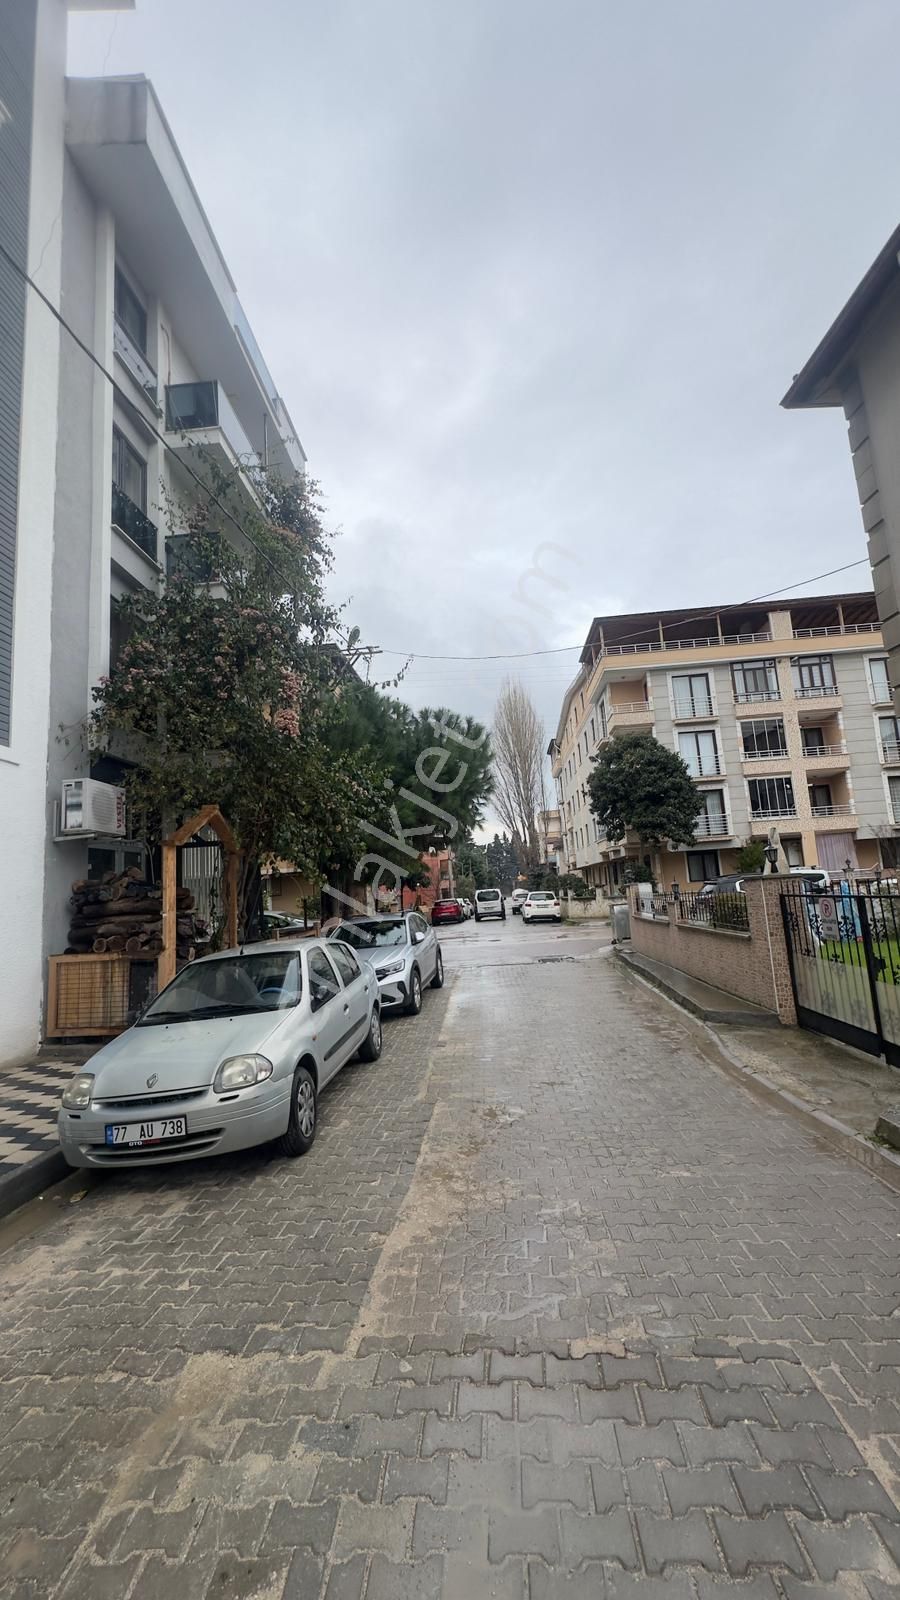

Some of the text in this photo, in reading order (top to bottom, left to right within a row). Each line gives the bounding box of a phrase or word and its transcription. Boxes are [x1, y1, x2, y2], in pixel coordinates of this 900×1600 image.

[114, 1120, 182, 1141] 77 AU 738
